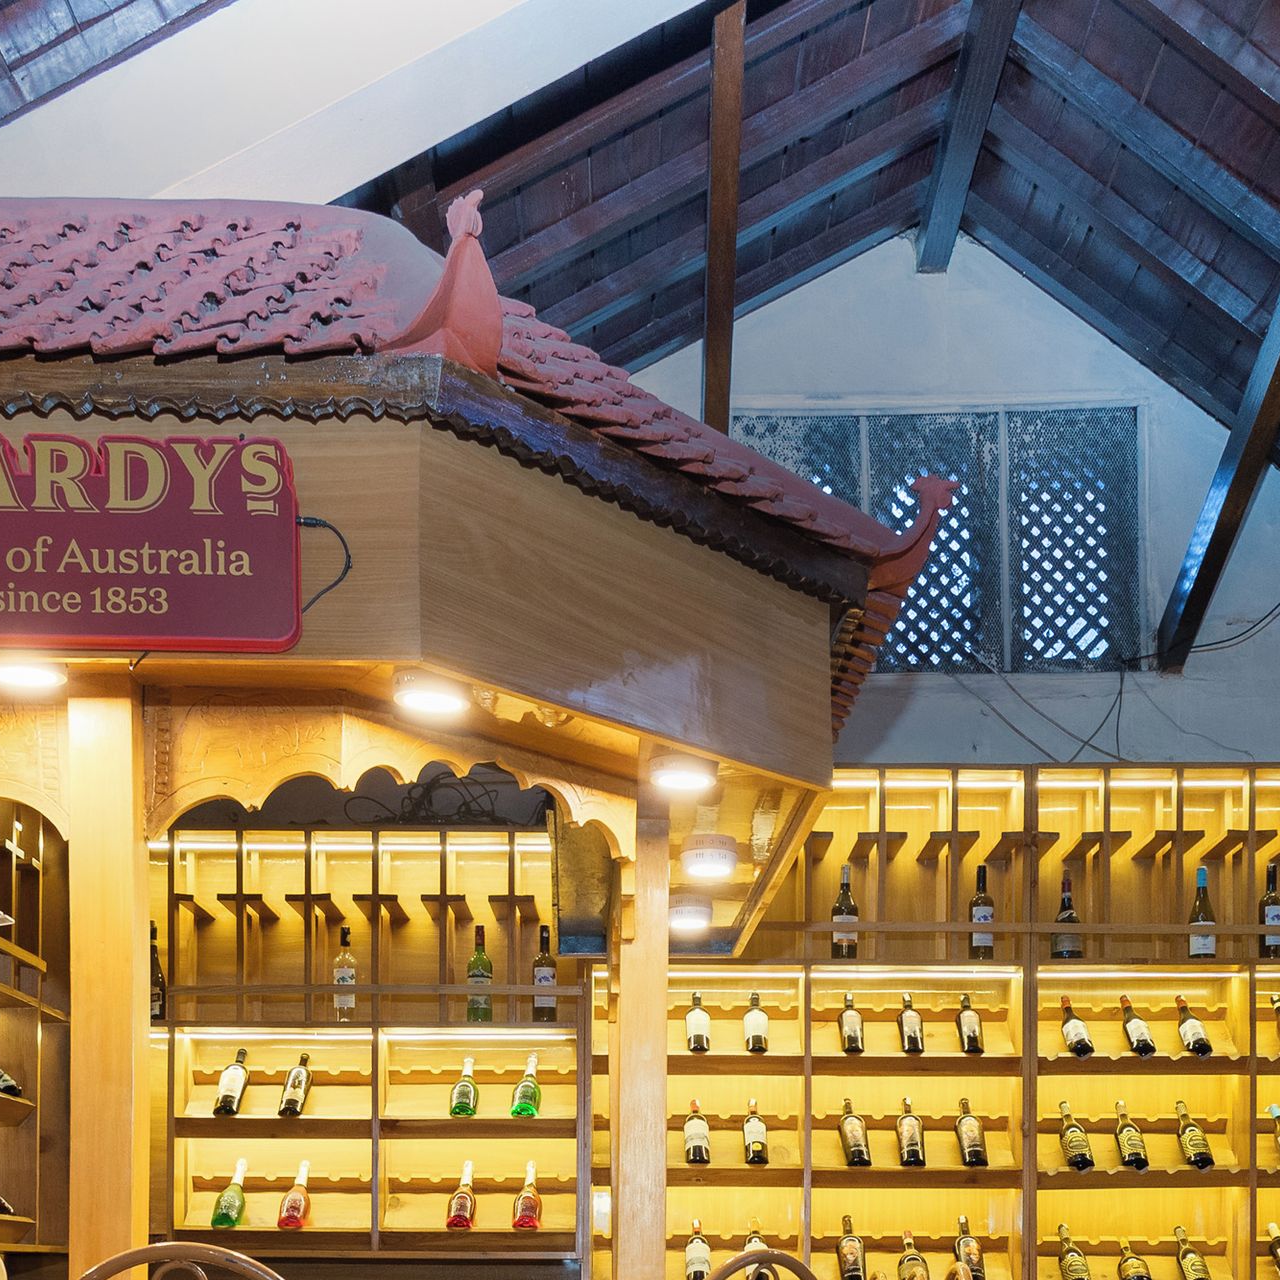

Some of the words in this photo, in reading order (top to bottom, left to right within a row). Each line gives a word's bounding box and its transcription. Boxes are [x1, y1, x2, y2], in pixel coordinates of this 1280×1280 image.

[5, 535, 53, 574] of
[56, 537, 254, 577] Australia
[89, 587, 169, 615] 1853
